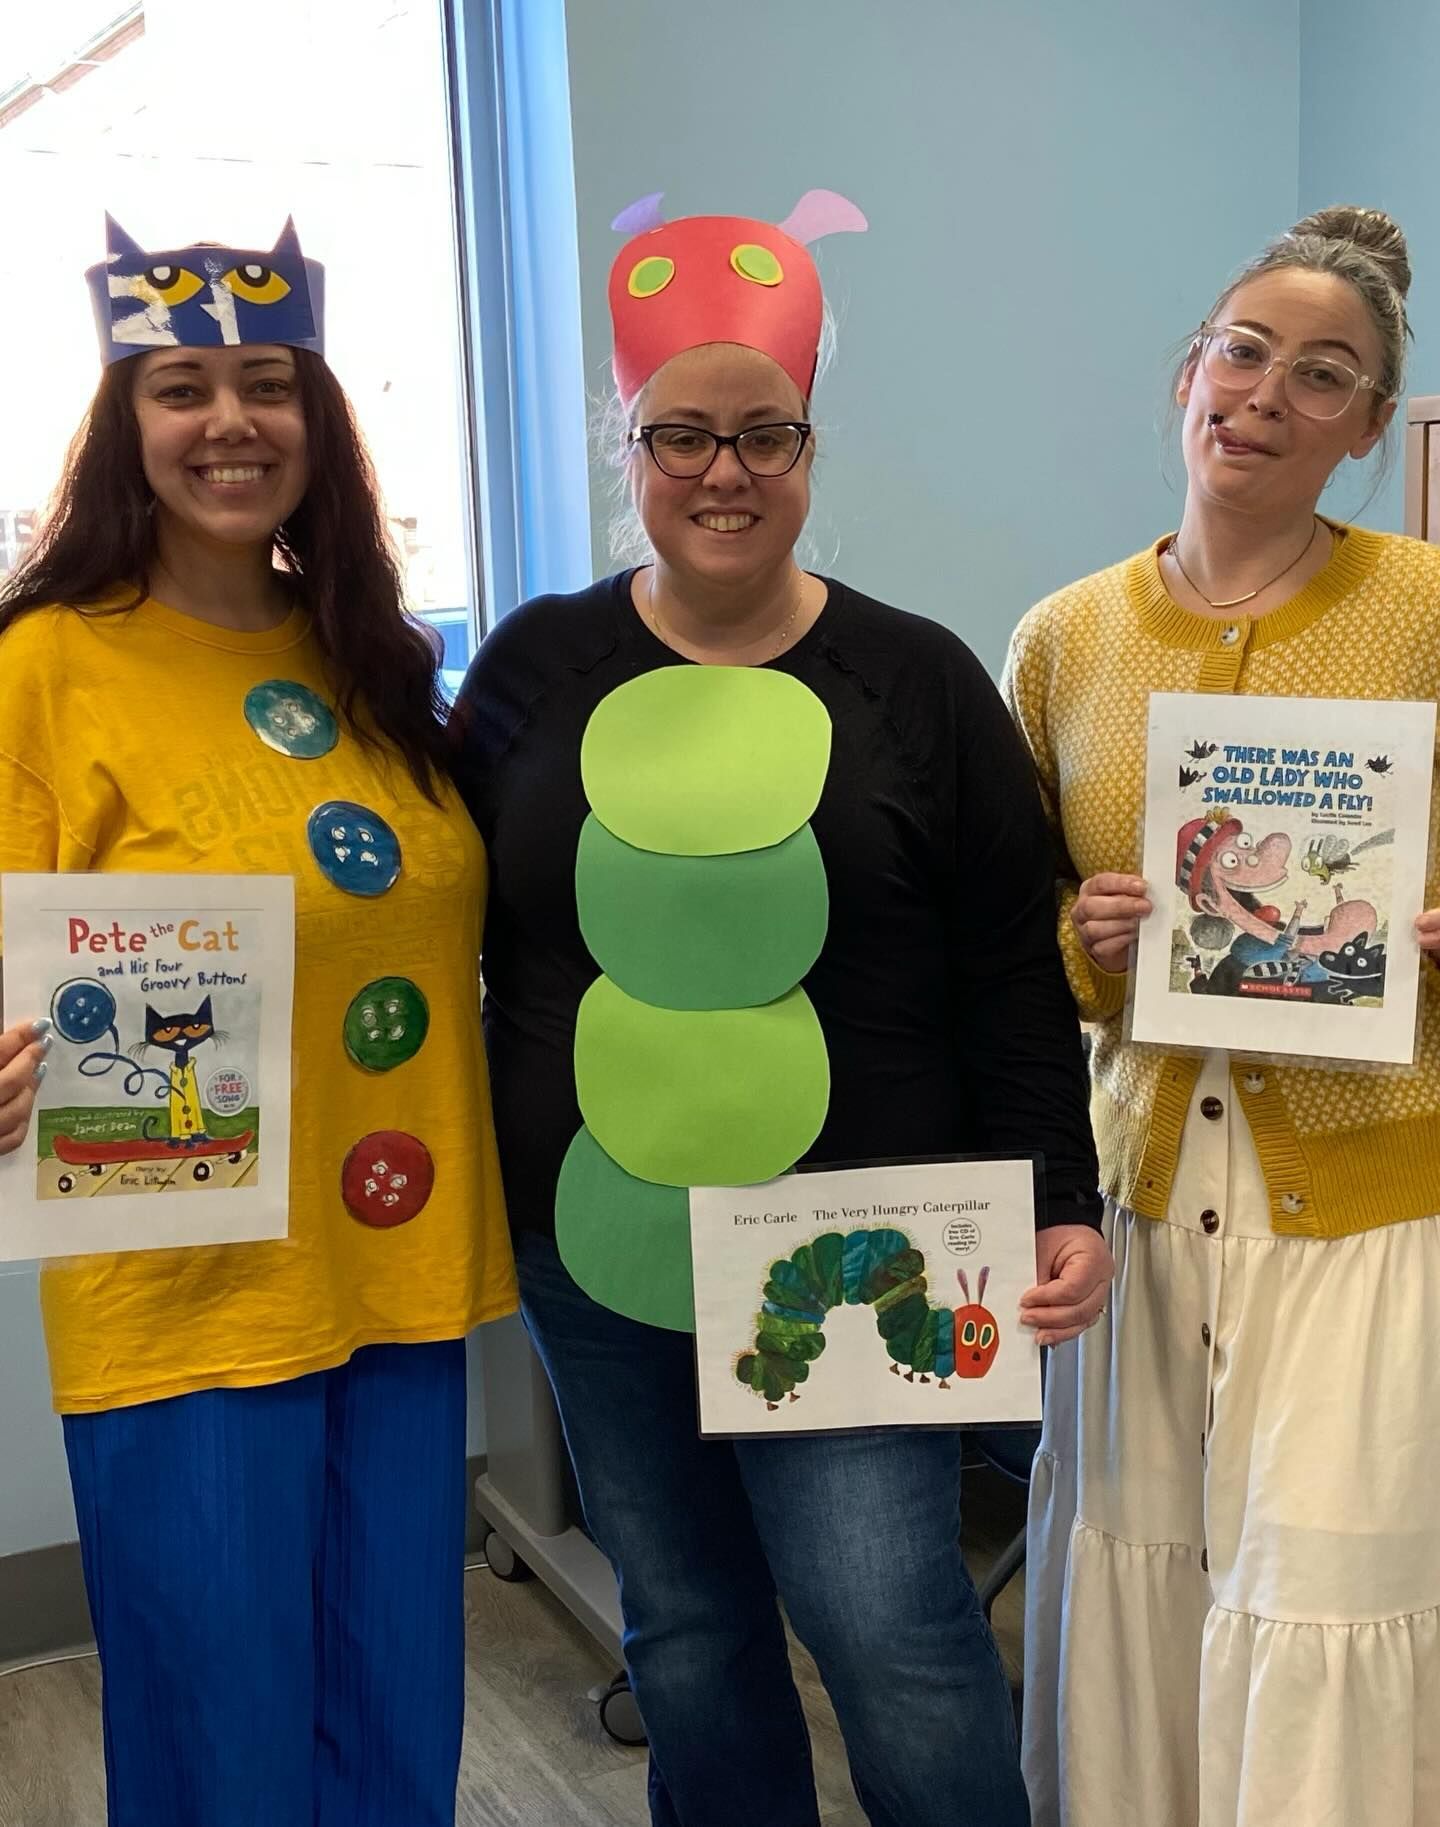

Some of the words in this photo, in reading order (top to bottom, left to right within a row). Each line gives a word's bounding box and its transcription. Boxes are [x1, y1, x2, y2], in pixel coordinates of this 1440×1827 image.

[1223, 746, 1277, 765] THERE
[1282, 749, 1320, 767] WAS
[1323, 751, 1354, 768] AN
[1212, 766, 1255, 784] OLD
[1259, 767, 1310, 787] LADY
[1314, 770, 1363, 790] WHO
[1201, 787, 1316, 808] SWALLOWED
[1319, 793, 1333, 810] A
[1337, 794, 1373, 812] FLY!
[68, 917, 147, 954] Pete
[150, 922, 174, 938] the
[178, 919, 239, 952] Cat
[97, 961, 123, 977] and
[130, 958, 149, 974] His
[155, 958, 183, 973] Four
[140, 976, 191, 992] Groovy
[198, 972, 247, 986] Buttons
[219, 1073, 236, 1082] FOR
[214, 1082, 242, 1095] FREE
[73, 1123, 106, 1135] James
[110, 1121, 137, 1131] Dean
[120, 1174, 139, 1186] Eric
[734, 1214, 760, 1225] Eric
[763, 1212, 798, 1224] Carle
[812, 1209, 838, 1221] The
[841, 1207, 869, 1219] Very
[872, 1204, 919, 1217] Hungry
[922, 1200, 991, 1214] Caterpillar
